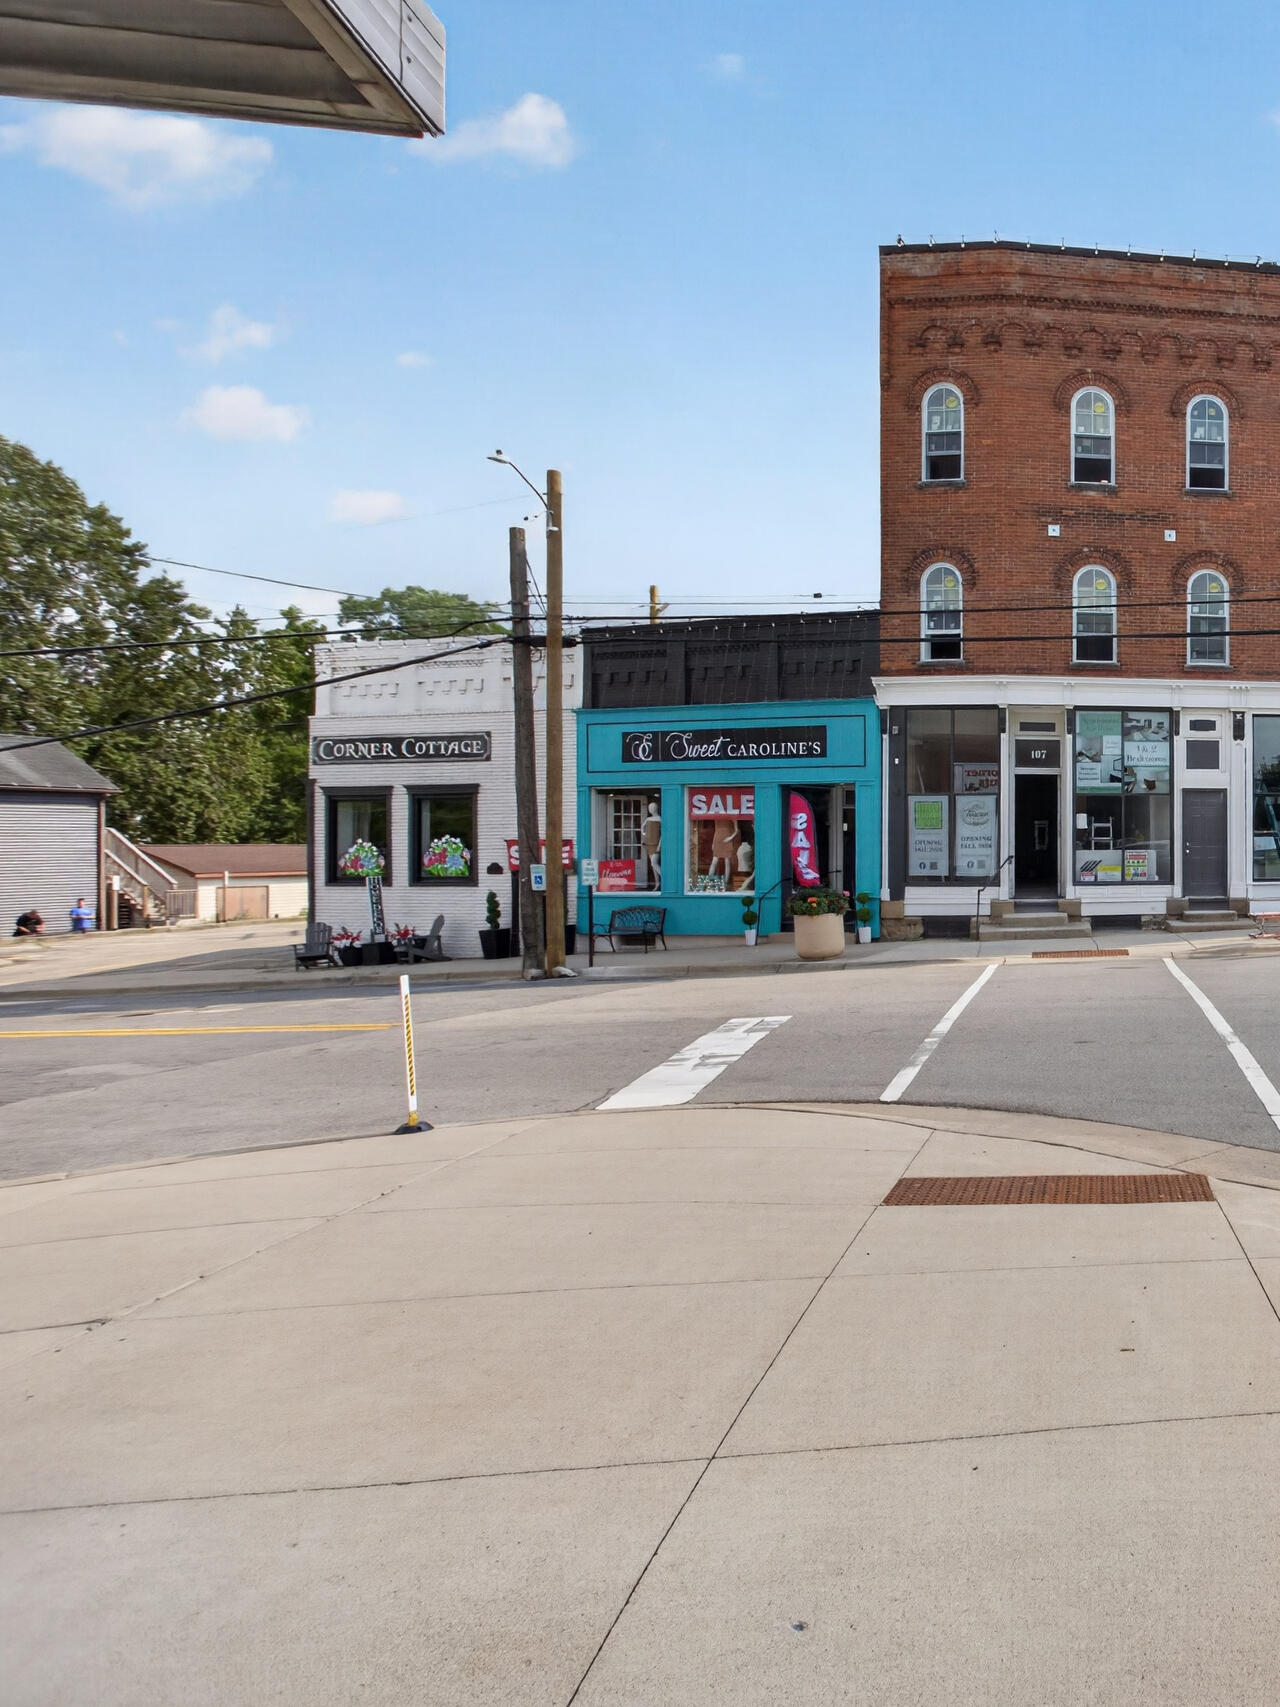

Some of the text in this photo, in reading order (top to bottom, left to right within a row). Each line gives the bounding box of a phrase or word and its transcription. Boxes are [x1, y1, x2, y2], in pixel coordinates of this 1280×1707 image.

[319, 738, 484, 760] CORNER COTTAGE
[665, 732, 821, 759] Sweet CAROLINE'S
[1031, 750, 1047, 759] 107
[692, 794, 755, 815] SALE
